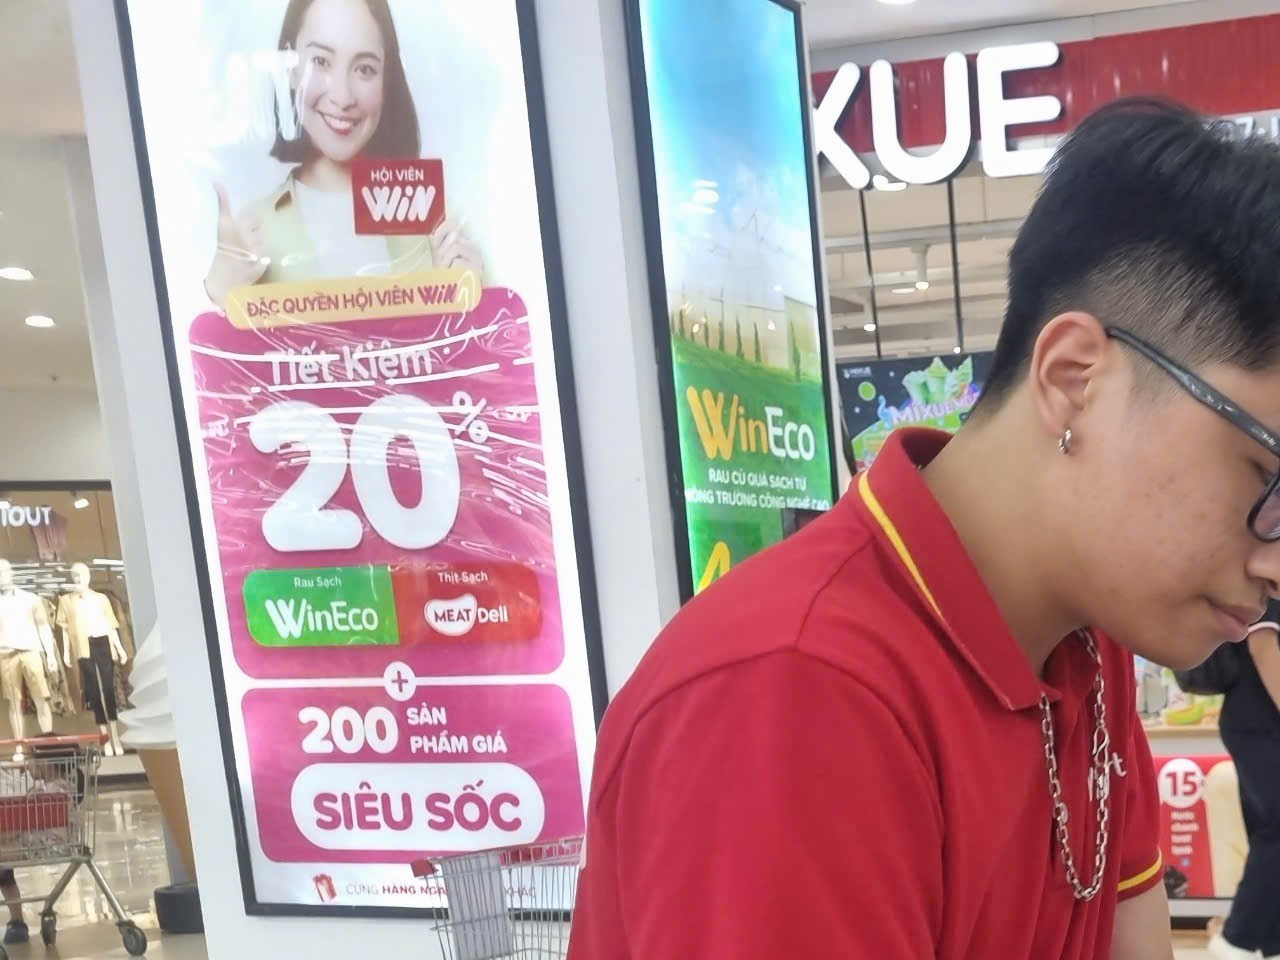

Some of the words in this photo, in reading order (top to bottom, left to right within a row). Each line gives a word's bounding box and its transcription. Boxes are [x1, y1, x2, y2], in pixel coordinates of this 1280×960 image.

[370, 166, 393, 184] HỘI
[395, 165, 424, 181] VIÊN
[282, 292, 339, 315] QUYỀN
[343, 288, 373, 312] HỘI
[377, 284, 415, 307] VIÊN
[686, 385, 815, 461] WinEco
[708, 467, 730, 484] RAU
[294, 576, 314, 588] Rau
[265, 598, 378, 639] WinEco
[298, 706, 398, 754] 200
[472, 729, 507, 753] GIÁ
[312, 781, 413, 831] SIÊU
[424, 779, 523, 833] SỐC
